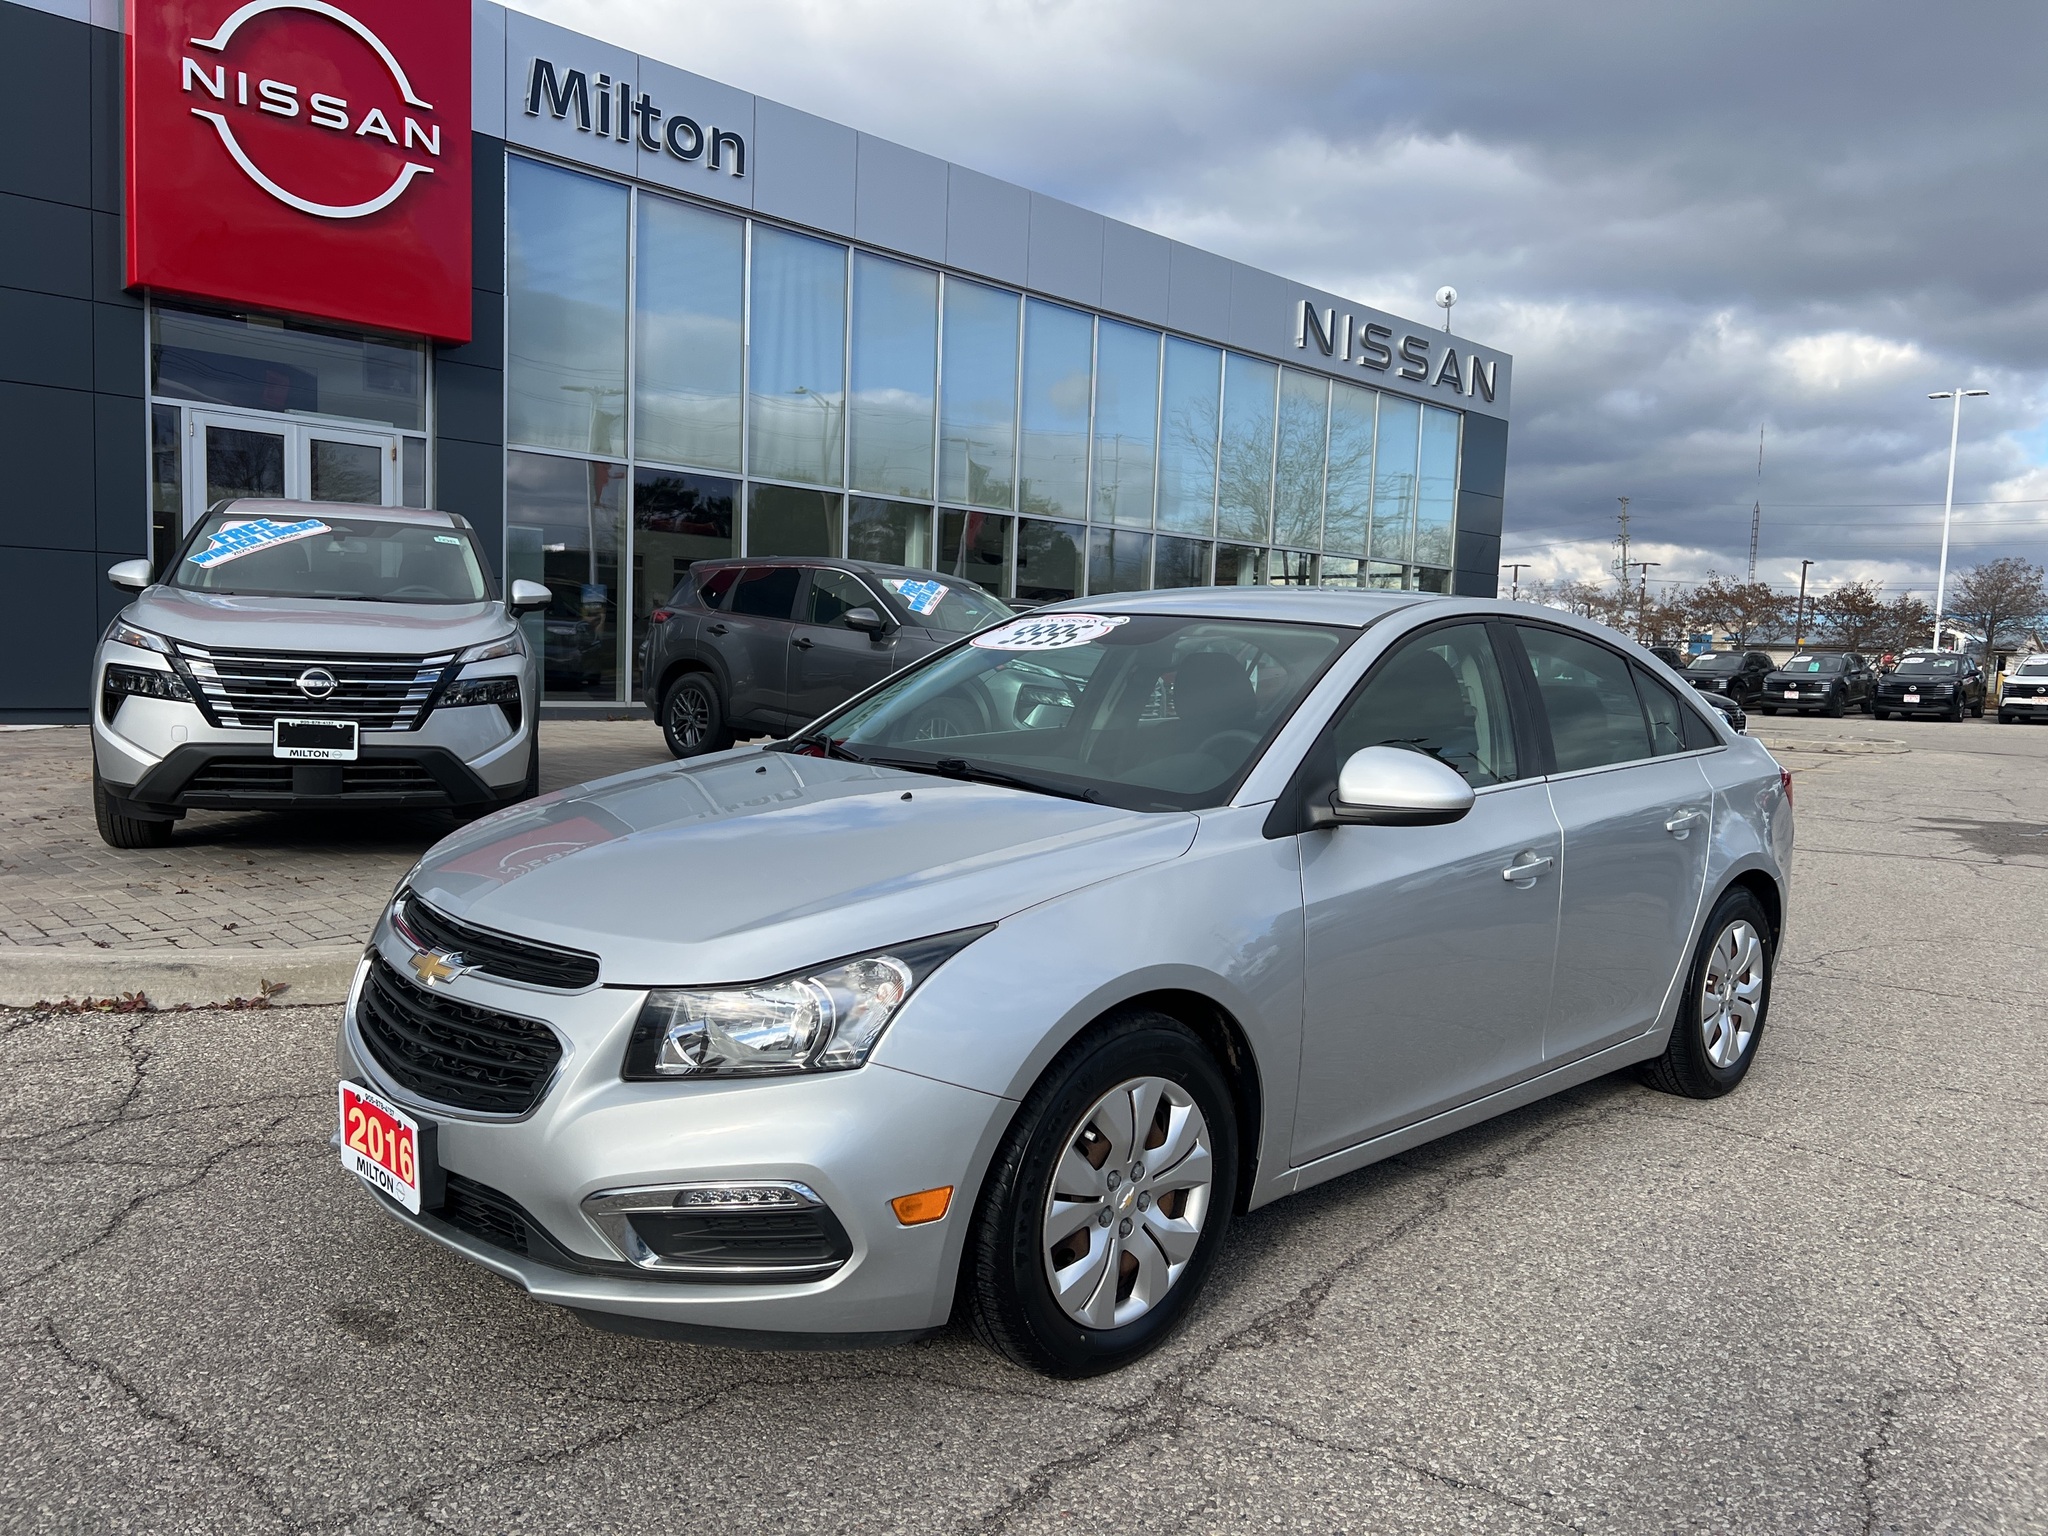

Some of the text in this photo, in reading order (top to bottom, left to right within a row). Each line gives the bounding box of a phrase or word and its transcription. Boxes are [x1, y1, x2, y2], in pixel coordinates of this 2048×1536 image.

[182, 56, 440, 156] NISSAN
[525, 56, 746, 177] Milton
[1297, 300, 1497, 402] NISSAN
[190, 535, 263, 563] WINTER
[211, 518, 280, 544] FREE
[296, 679, 339, 688] ISSAN
[289, 749, 330, 758] MILTON
[348, 1106, 414, 1184] 2016
[356, 1156, 394, 1194] MILTON
